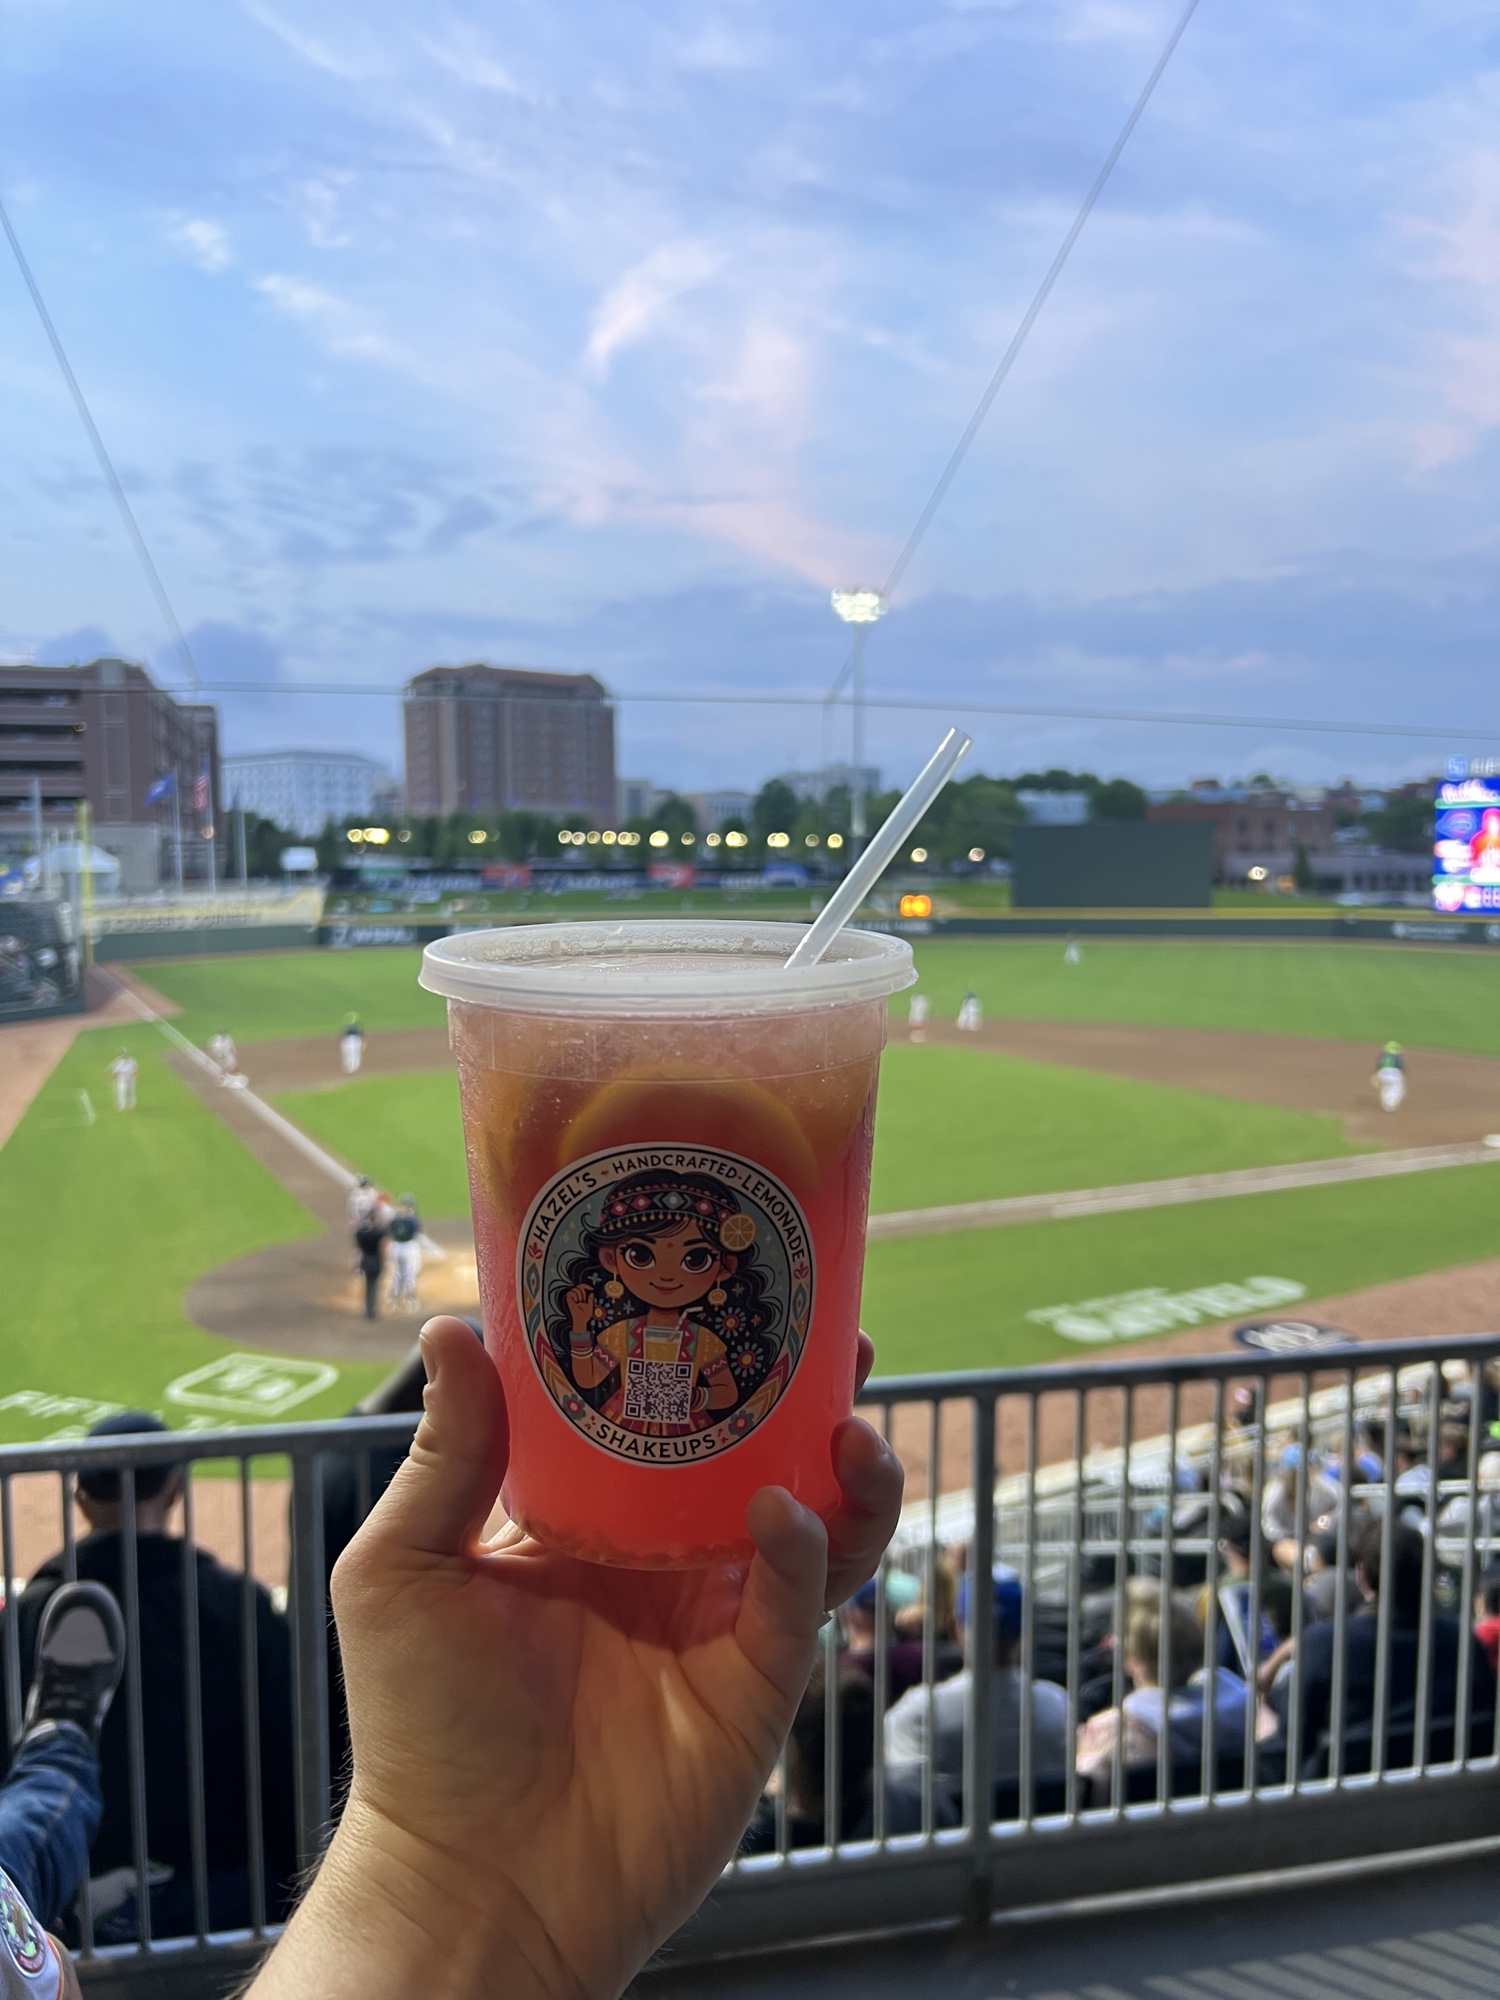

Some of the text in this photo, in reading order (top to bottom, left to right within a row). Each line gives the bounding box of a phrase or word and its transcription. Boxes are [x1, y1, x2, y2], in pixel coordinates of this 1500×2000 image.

[533, 1154, 805, 1263] HAZEL'S HANDCRAFTED LEMONADE
[596, 1423, 717, 1458] SHAKEUPS
